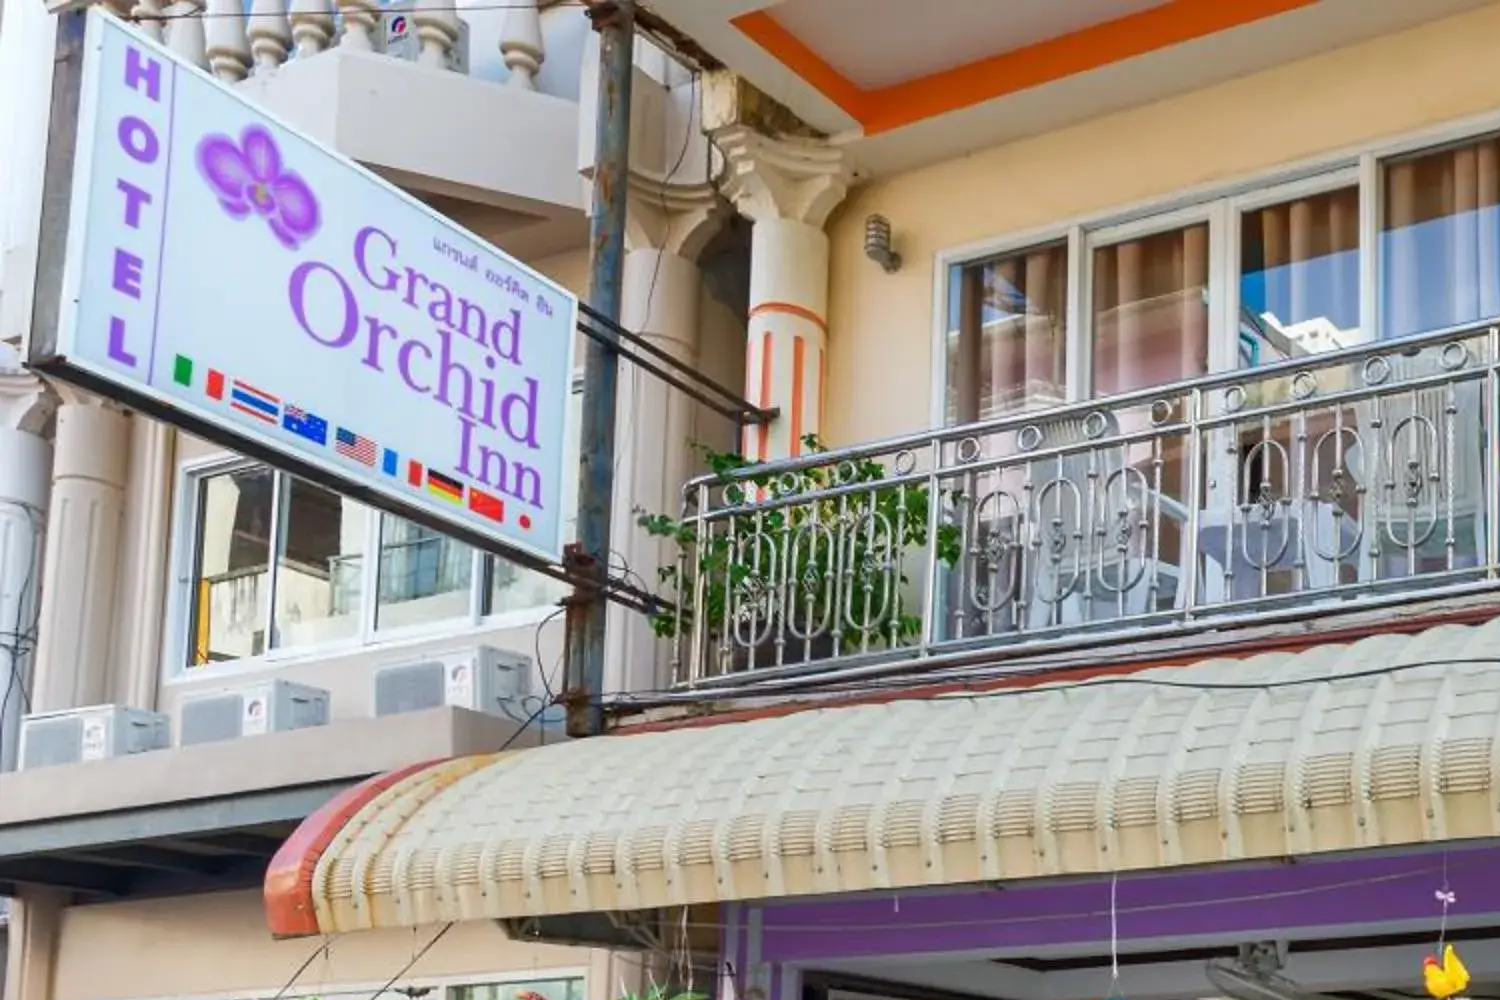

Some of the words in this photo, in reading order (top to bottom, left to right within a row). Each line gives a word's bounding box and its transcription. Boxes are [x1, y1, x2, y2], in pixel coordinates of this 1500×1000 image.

[108, 46, 161, 369] HOTEL
[288, 261, 541, 449] Orchid
[354, 226, 522, 365] Grand
[454, 415, 544, 509] Inn
